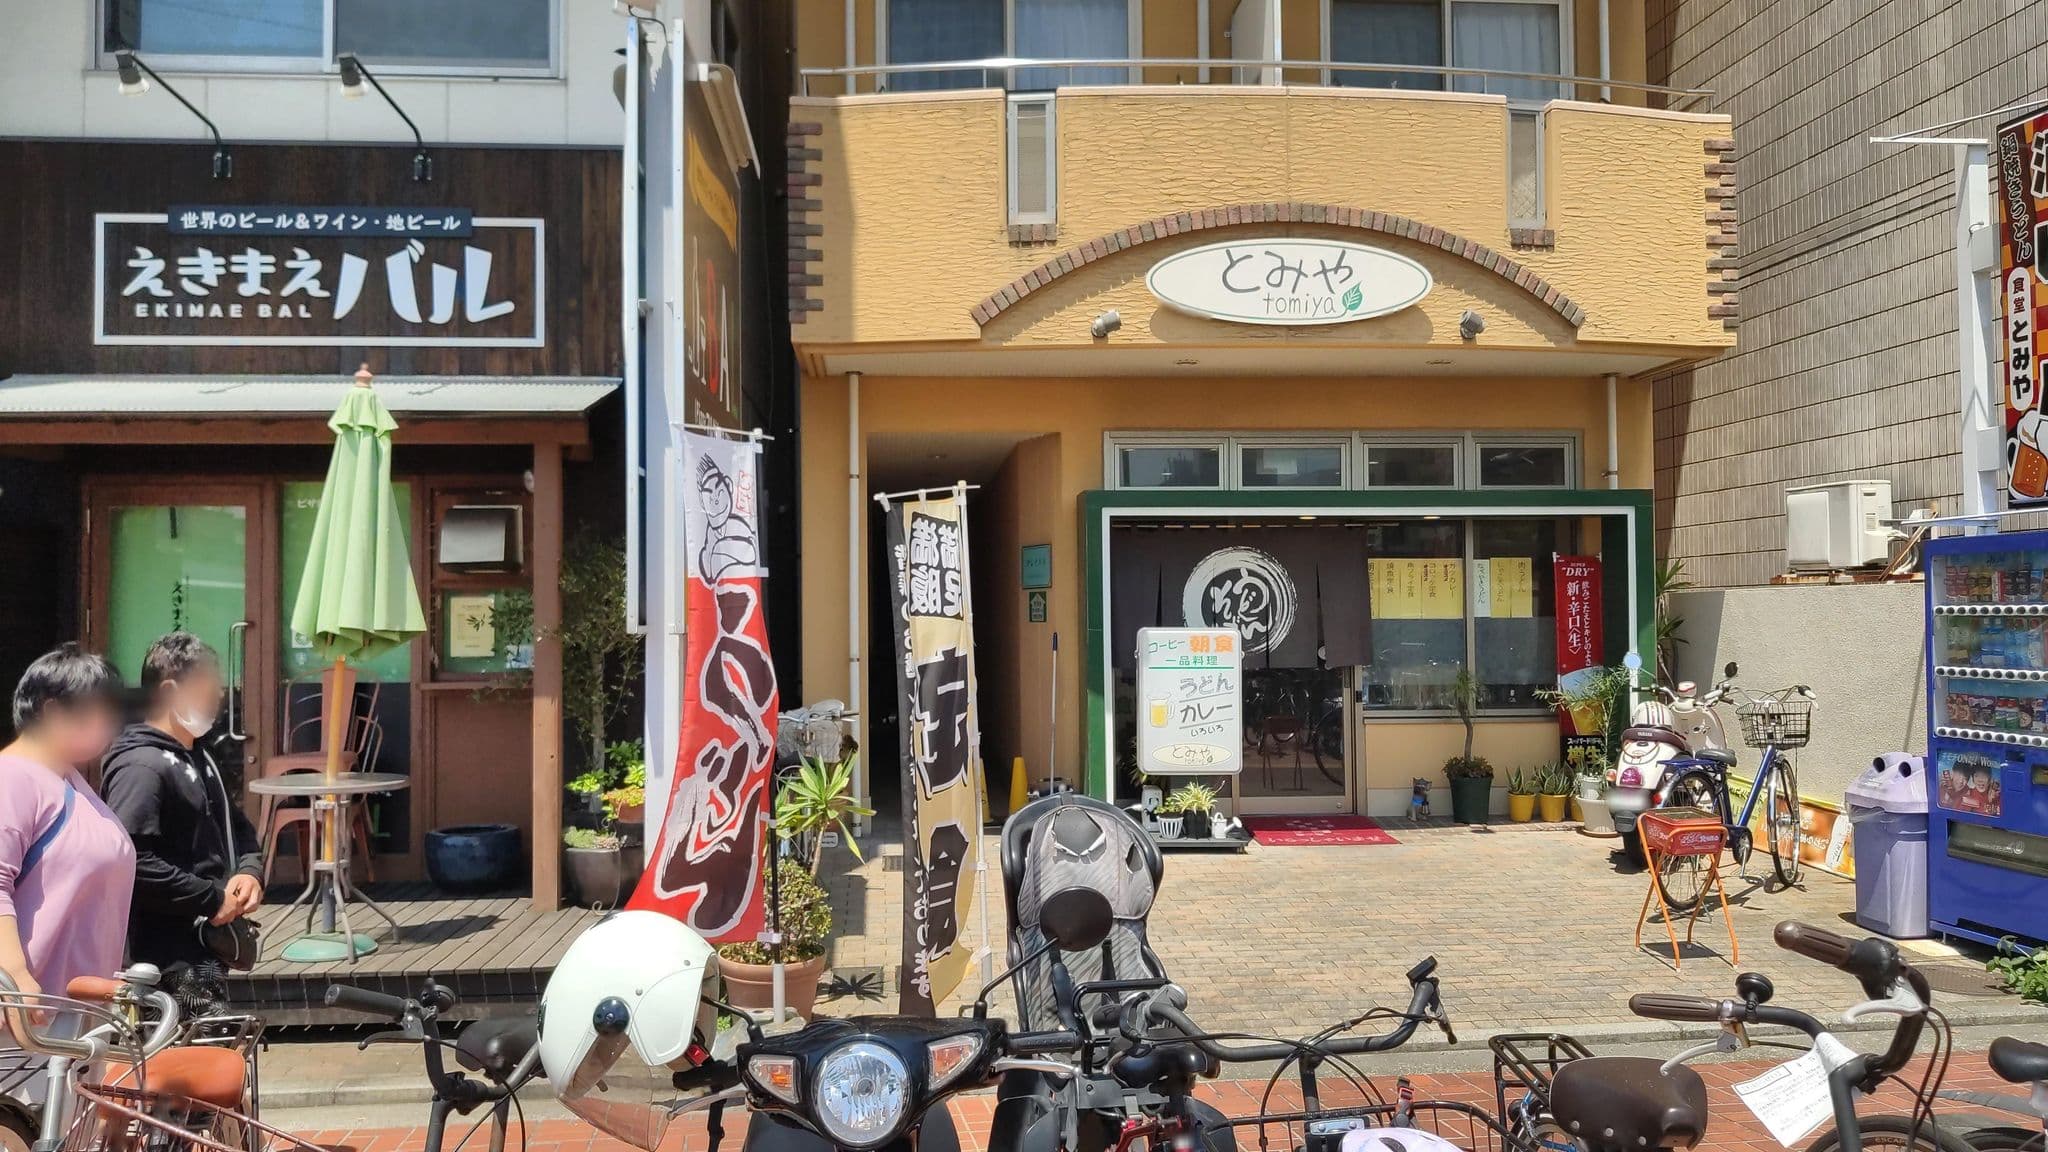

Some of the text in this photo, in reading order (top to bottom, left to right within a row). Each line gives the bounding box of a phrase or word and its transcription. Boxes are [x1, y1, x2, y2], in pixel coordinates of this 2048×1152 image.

[2000, 133, 2032, 262] 鍋焼きうどん
[122, 238, 515, 324] えきまえバル
[1222, 249, 1353, 294] とみや
[135, 303, 312, 318] EKIMAE BAL
[1263, 292, 1336, 317] tomiya
[2012, 277, 2031, 400] 食堂 とみや
[1148, 635, 1233, 654] コーヒー 朝食
[1165, 655, 1218, 666] 一品料理
[1180, 673, 1234, 698] うどん
[1180, 703, 1233, 723] カレー
[1190, 724, 1224, 737] いろいろ
[1172, 747, 1211, 760] とみや
